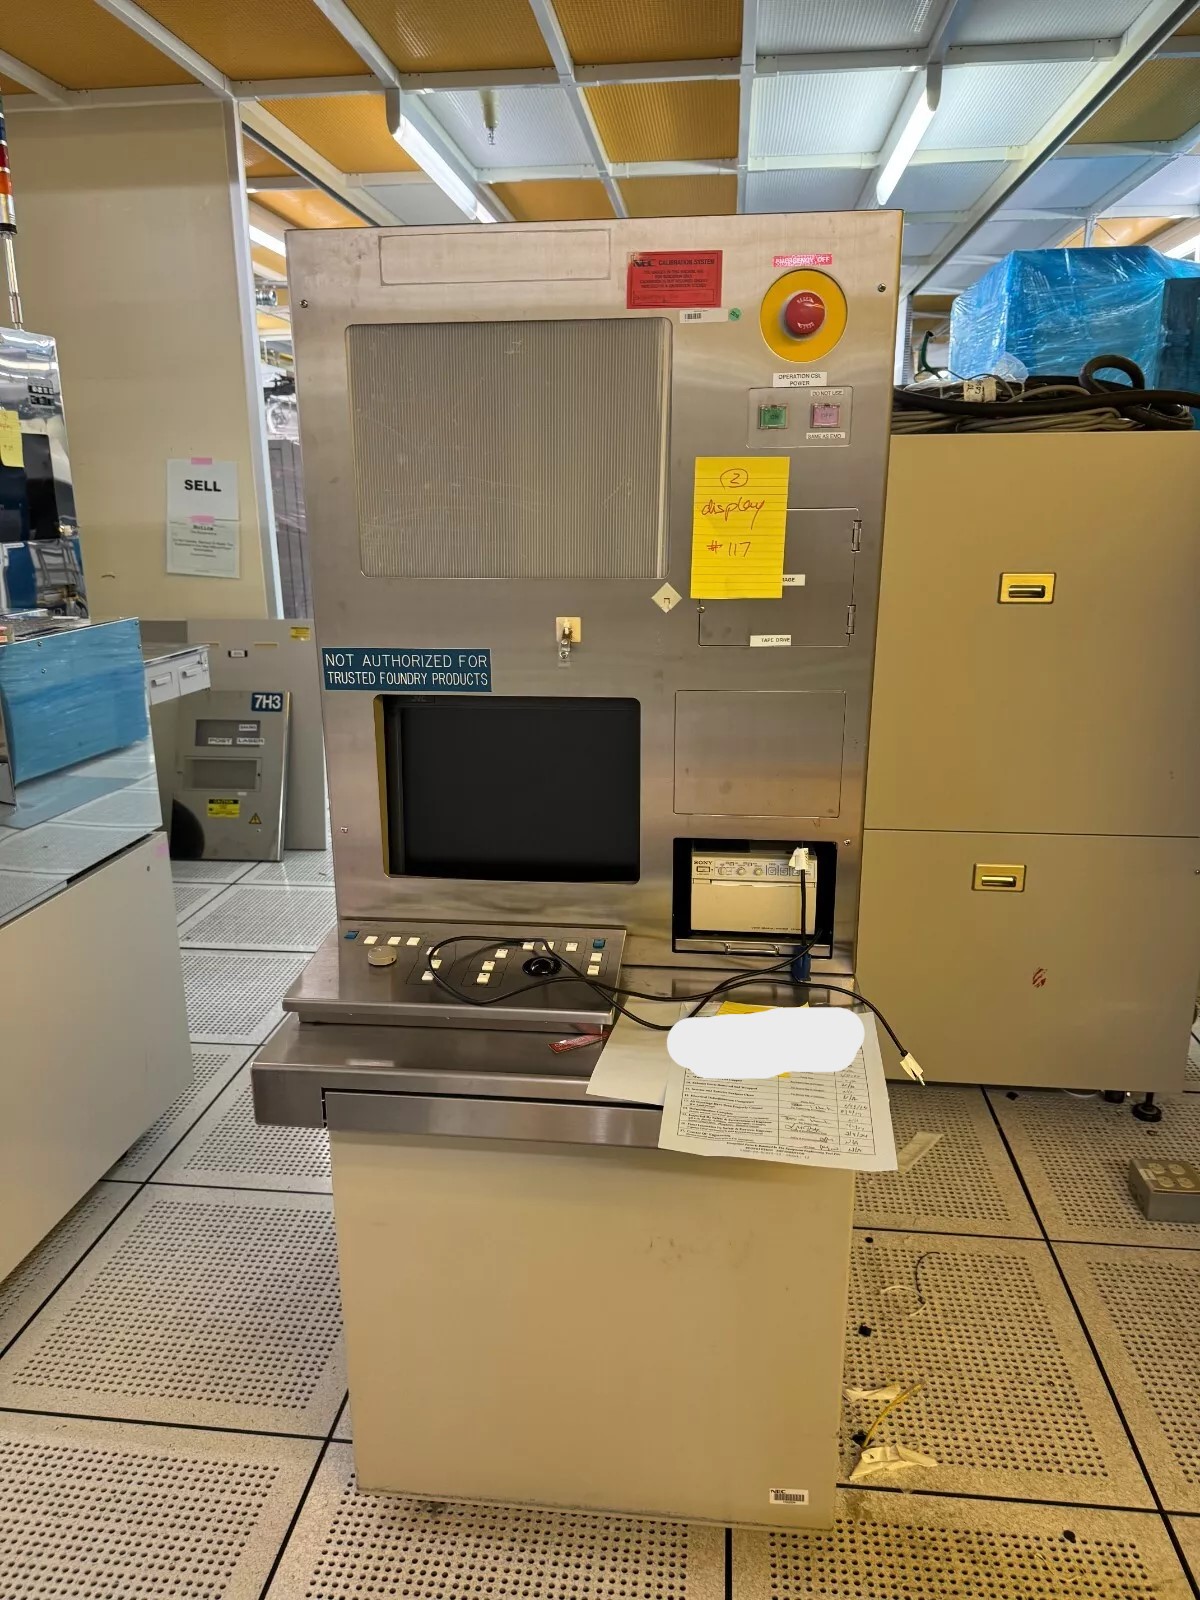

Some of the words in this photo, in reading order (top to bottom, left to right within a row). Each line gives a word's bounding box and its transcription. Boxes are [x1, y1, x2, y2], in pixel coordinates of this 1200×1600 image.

[184, 479, 222, 492] SELL
[701, 496, 765, 531] display
[706, 540, 723, 554] #
[728, 541, 751, 557] 117
[325, 653, 354, 667] NOT
[362, 654, 452, 668] AUTHORIZED
[458, 655, 488, 668] FOR
[327, 671, 376, 685] TRUSTED
[379, 672, 428, 685] FOUNDRY
[432, 672, 489, 686] PRODUCTS
[254, 694, 282, 709] 7H3
